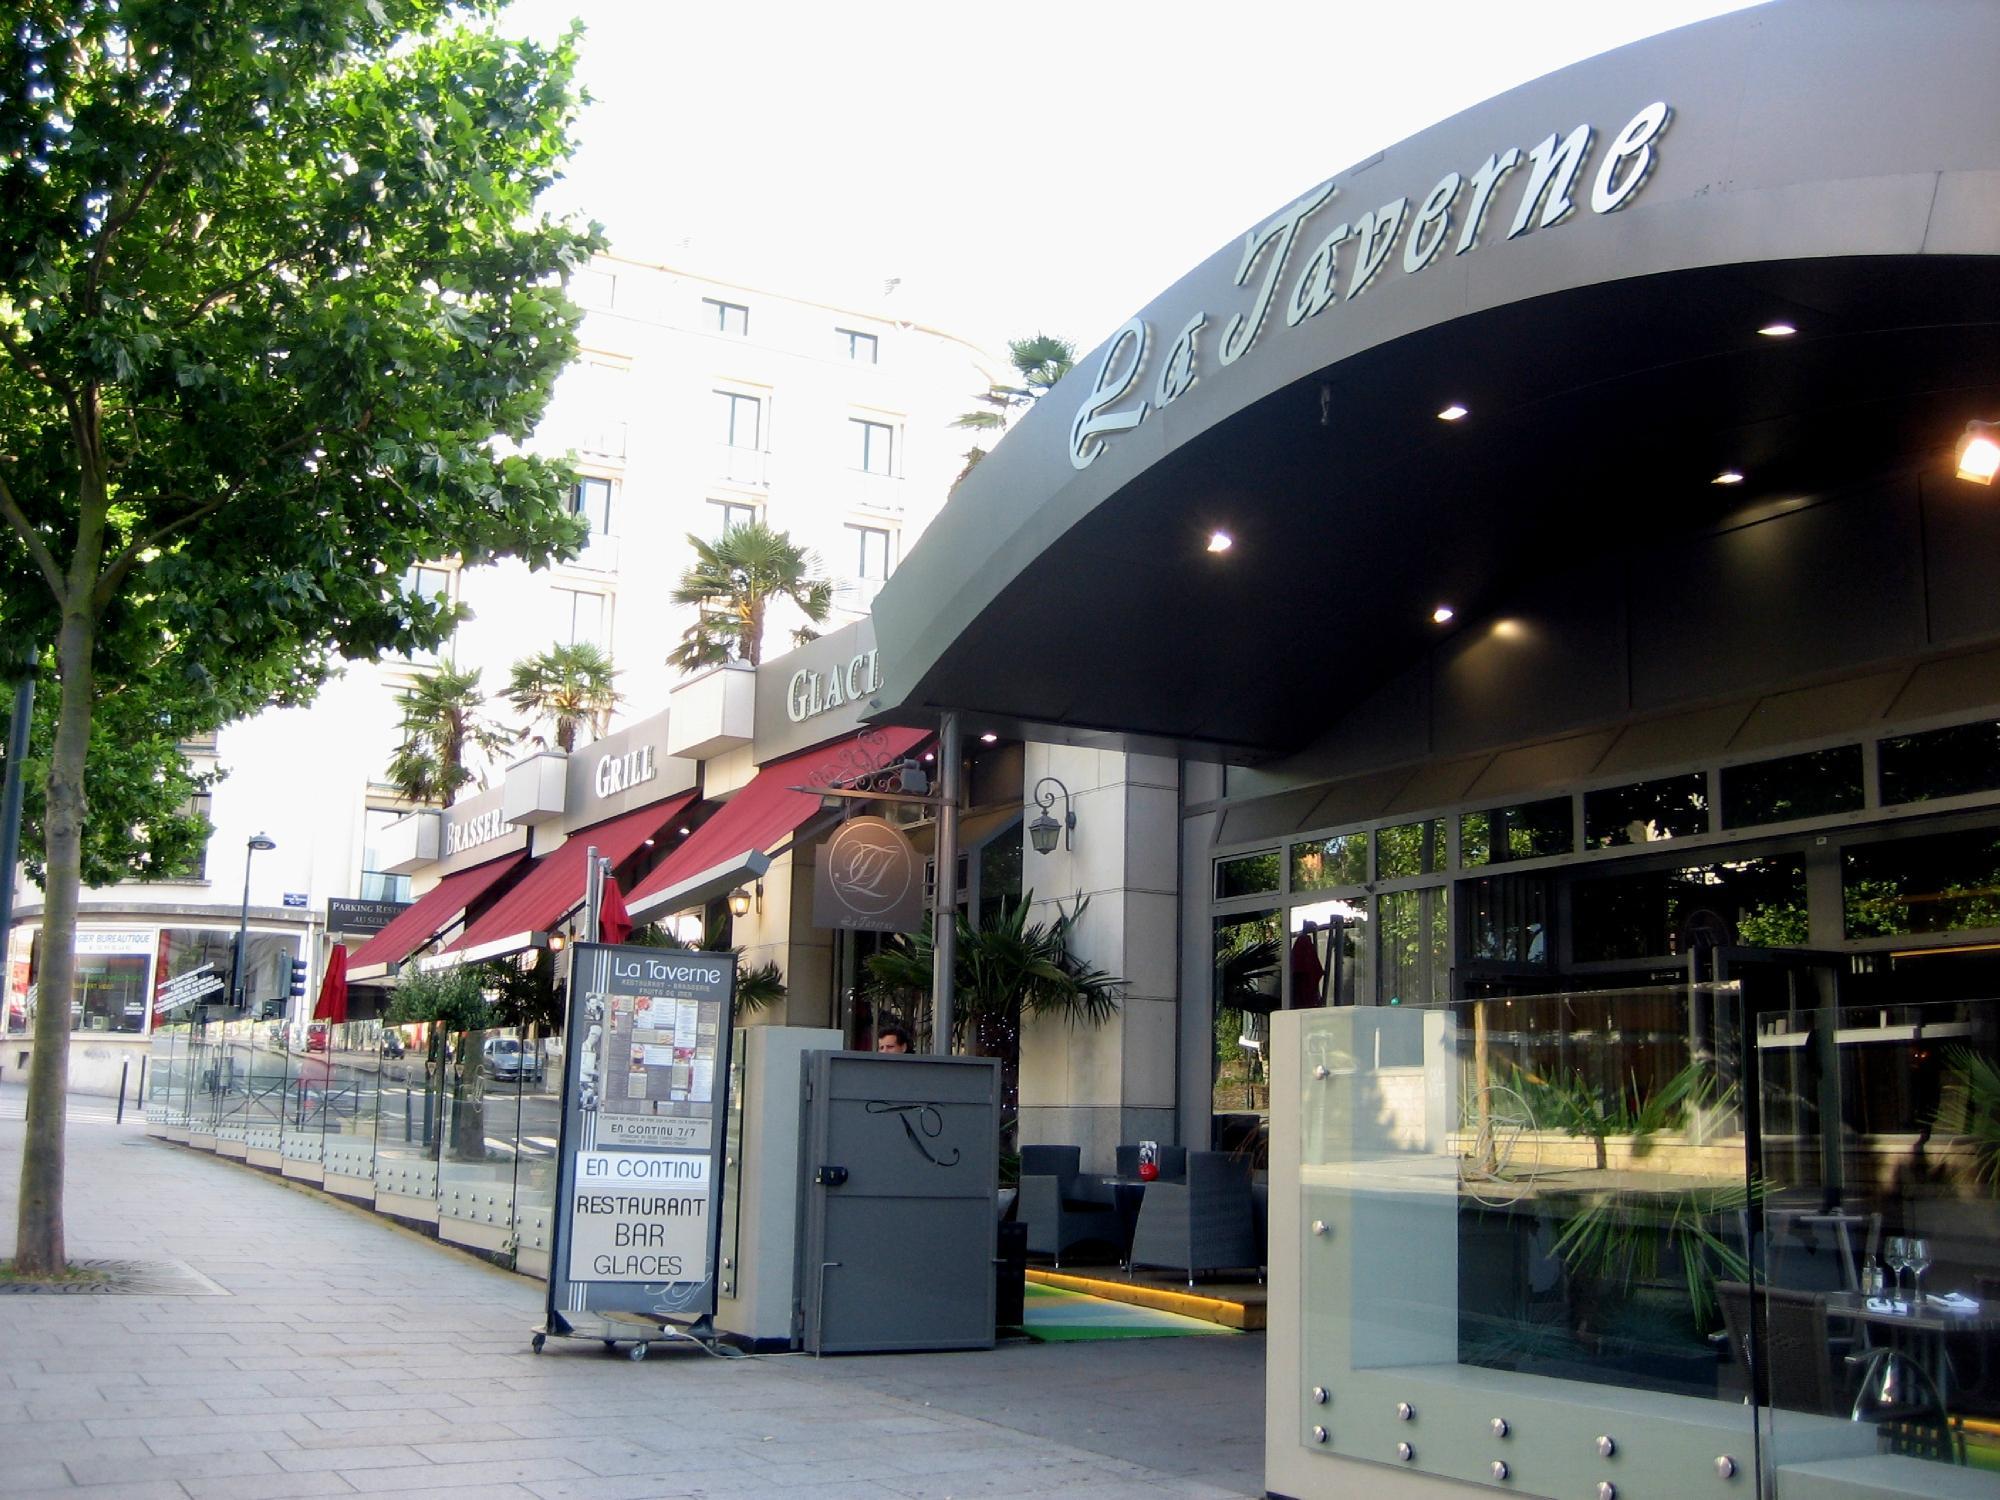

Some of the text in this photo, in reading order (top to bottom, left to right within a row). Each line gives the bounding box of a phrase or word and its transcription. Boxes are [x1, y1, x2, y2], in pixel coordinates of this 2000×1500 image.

[1069, 101, 1671, 470] La Taverne
[595, 744, 654, 799] GRILL
[332, 902, 373, 913] PARKING
[97, 934, 150, 943] BUREAUTIQUE
[615, 957, 721, 984] La Taverne
[611, 1124, 623, 1133] EN
[628, 1125, 673, 1136] CONTINU
[678, 1127, 696, 1137] 7/7
[586, 1158, 702, 1179] EN CONTINU
[577, 1195, 706, 1216] RESTAURANT
[615, 1223, 665, 1247] BAR
[594, 1254, 682, 1276] GLACES
